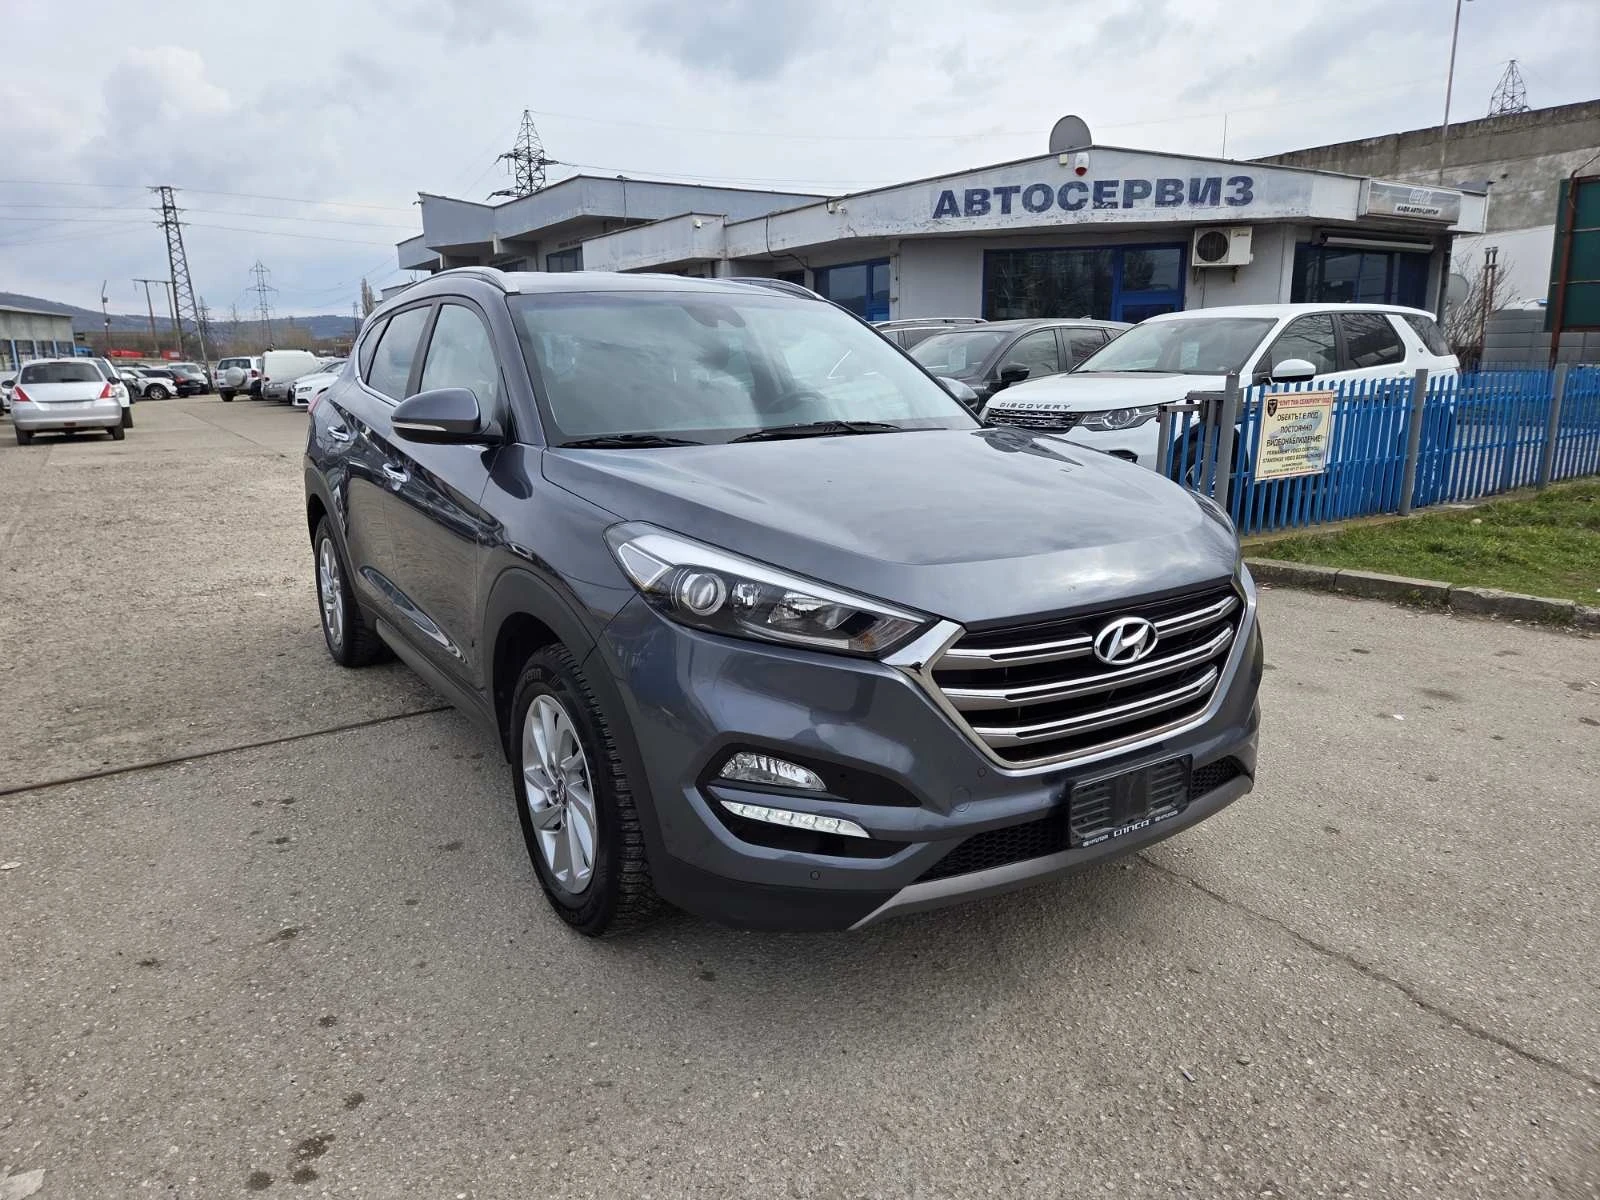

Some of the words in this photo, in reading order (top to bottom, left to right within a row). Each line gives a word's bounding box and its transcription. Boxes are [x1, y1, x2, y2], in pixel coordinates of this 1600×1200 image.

[932, 175, 1254, 219] АВТОСЕРВИЗ
[1000, 402, 1071, 410] DISCOVERY
[1277, 412, 1301, 421] ОБЕКТЪТ
[1307, 411, 1319, 419] ПОД
[1280, 424, 1313, 433] ПОСТОЯННО
